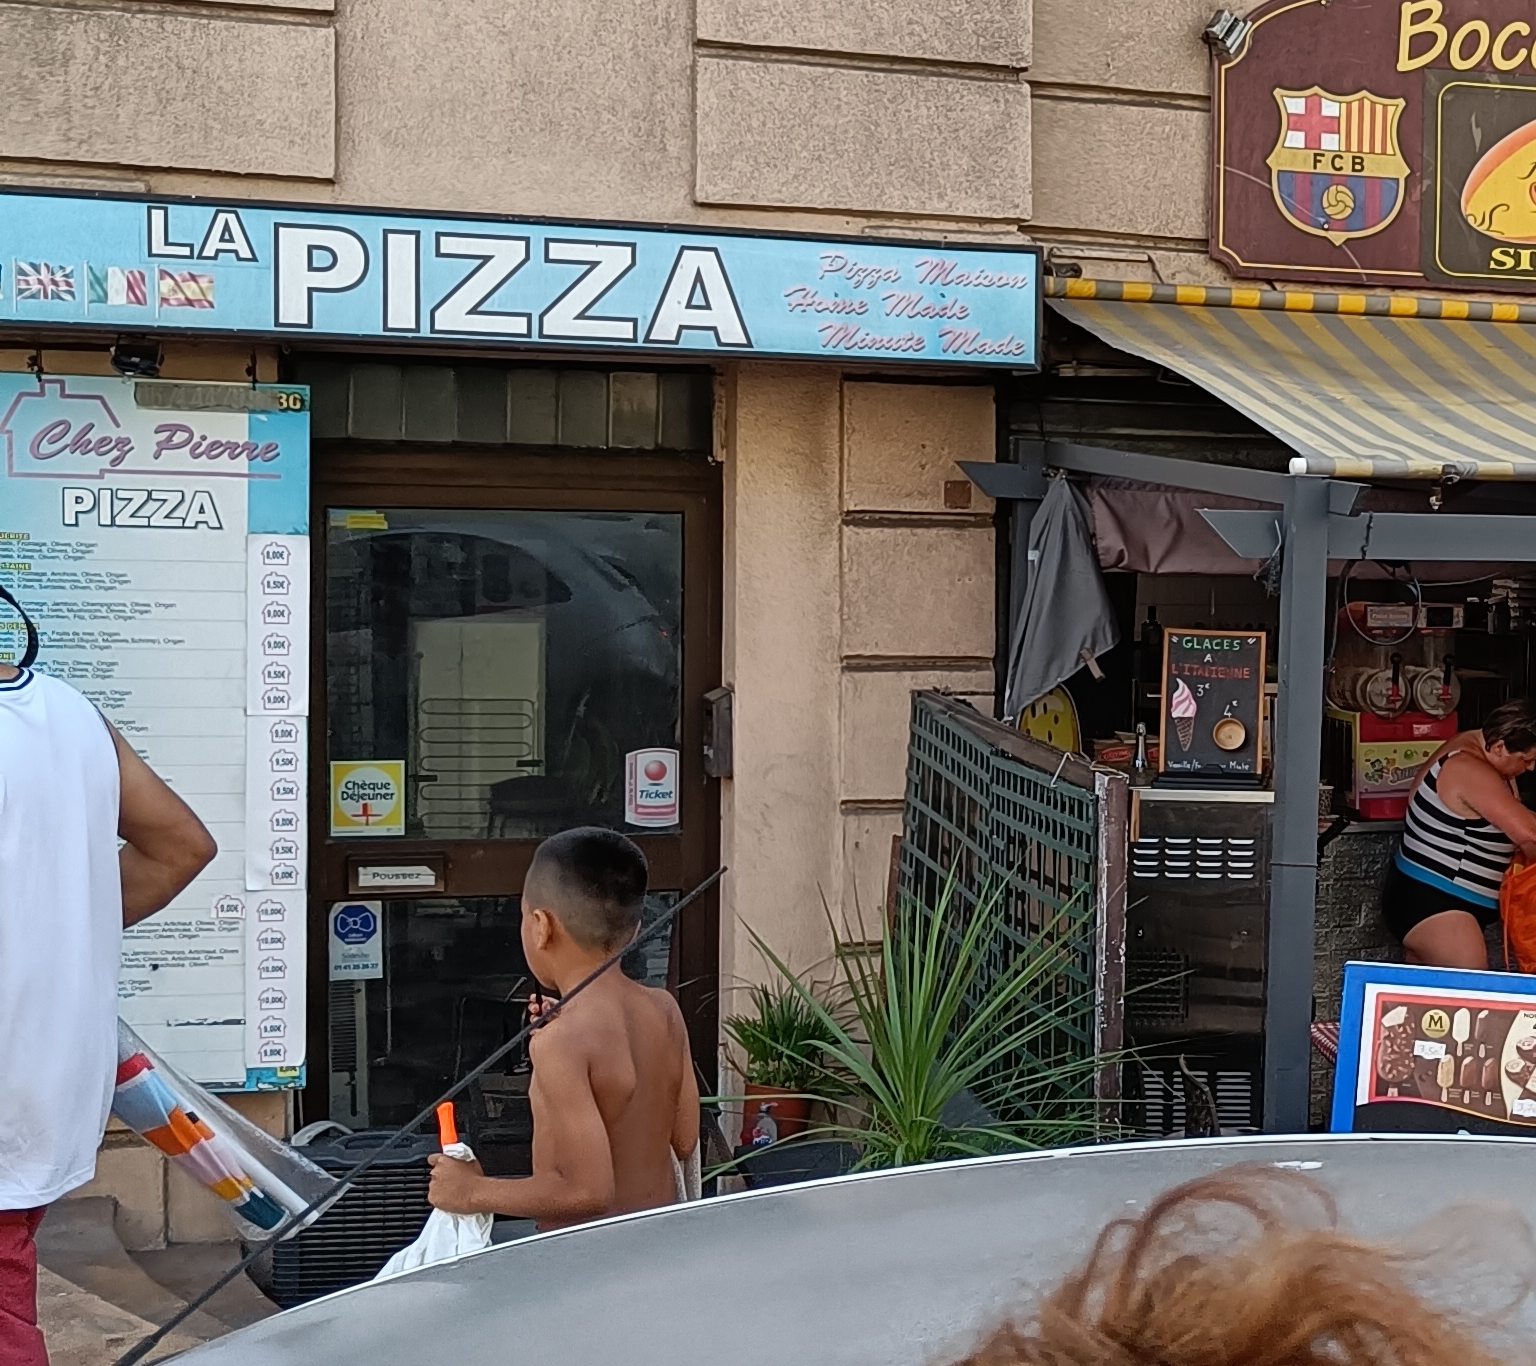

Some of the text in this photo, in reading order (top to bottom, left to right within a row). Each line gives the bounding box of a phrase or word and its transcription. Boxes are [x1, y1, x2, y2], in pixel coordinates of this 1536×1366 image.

[147, 205, 259, 262] LA
[274, 222, 754, 348] PIZZA
[818, 253, 1028, 290] Pizza Maison
[784, 285, 970, 320] Home Made
[818, 322, 1025, 356] Minute Made
[29, 419, 281, 468] Chez Pierre
[61, 486, 224, 530] PIZZA
[1182, 637, 1241, 651] GLACES
[1203, 653, 1213, 663] A
[341, 790, 395, 803] Déjeuner
[345, 779, 391, 792] Chèque
[639, 789, 674, 800] Ticket
